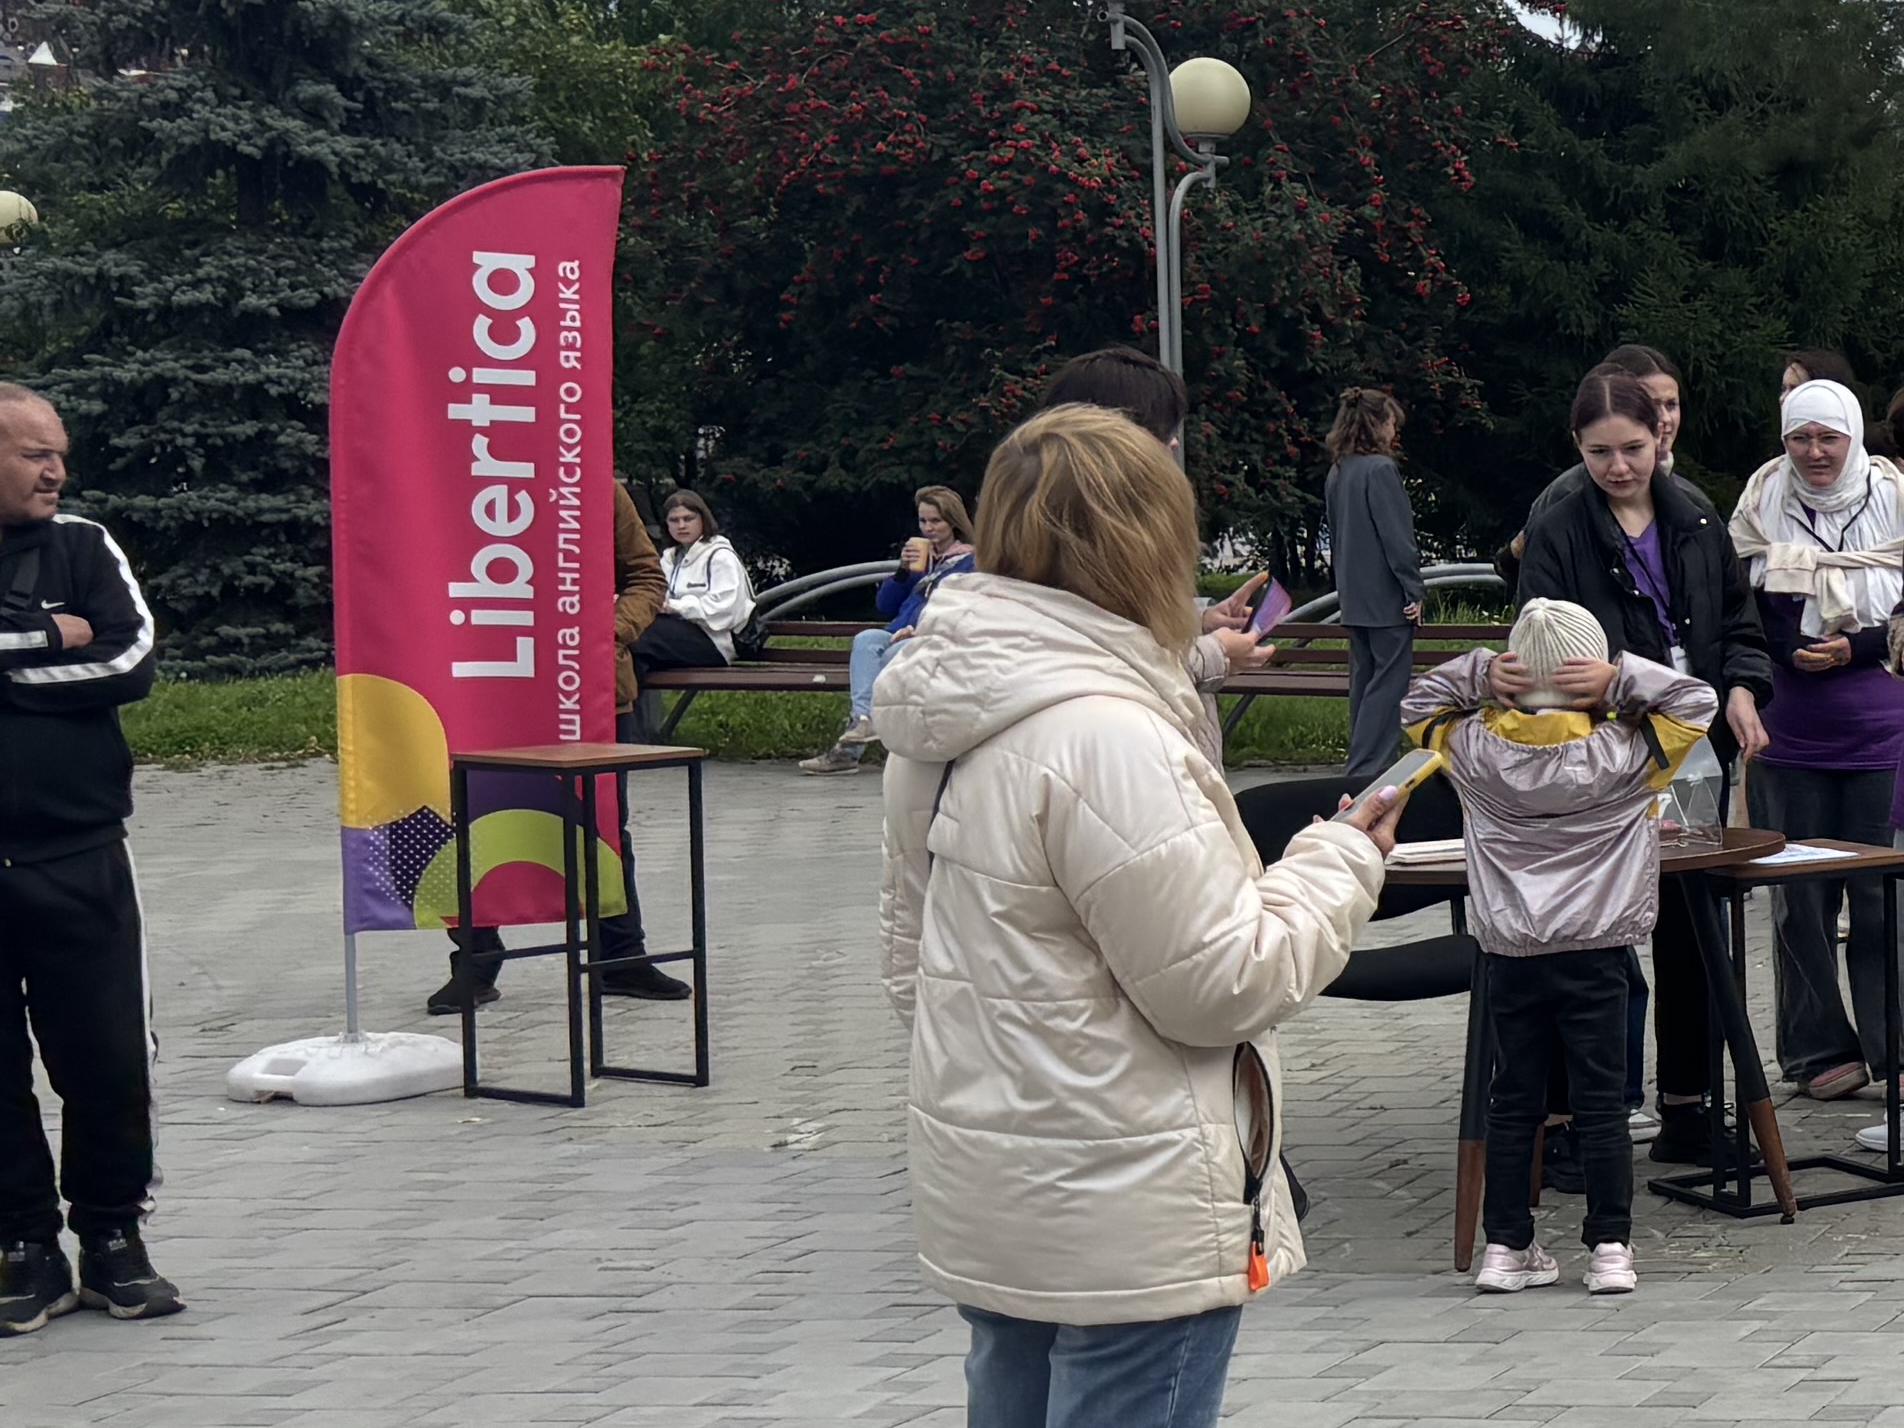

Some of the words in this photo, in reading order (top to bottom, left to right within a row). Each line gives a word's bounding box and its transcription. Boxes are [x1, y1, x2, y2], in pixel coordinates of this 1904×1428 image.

[558, 259, 582, 370] языка
[447, 250, 536, 678] Libertica
[549, 381, 582, 615] английского
[557, 625, 581, 741] школа
